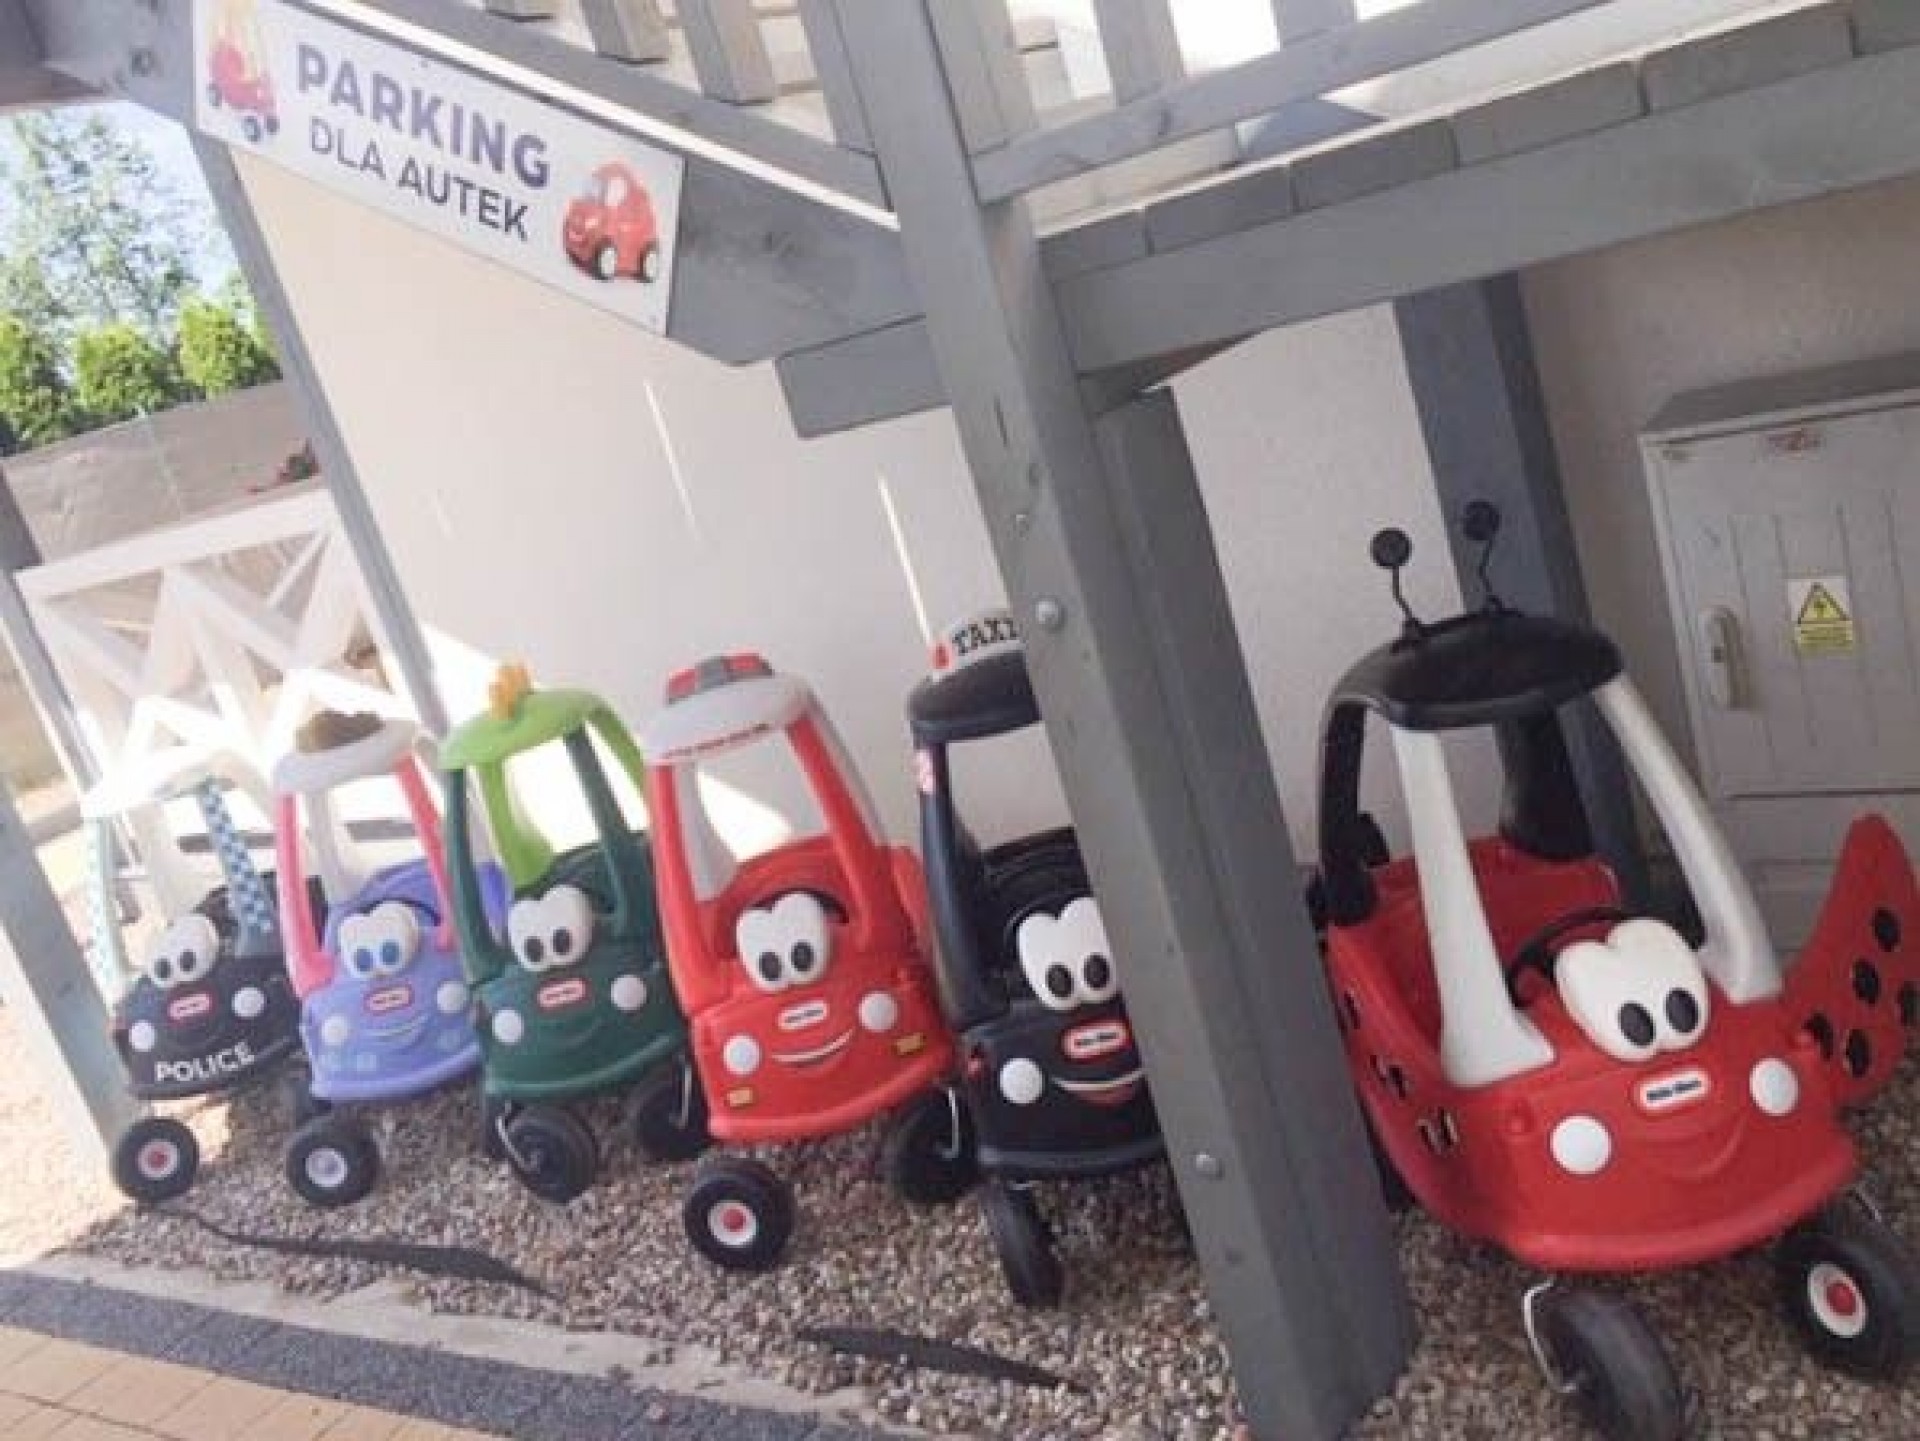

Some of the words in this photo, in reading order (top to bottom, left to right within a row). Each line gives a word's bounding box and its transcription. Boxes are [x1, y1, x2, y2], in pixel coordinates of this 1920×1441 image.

[297, 43, 550, 189] PARKING
[310, 117, 386, 181] DLA
[399, 156, 529, 241] AUTEK
[155, 1041, 255, 1081] POLICE
